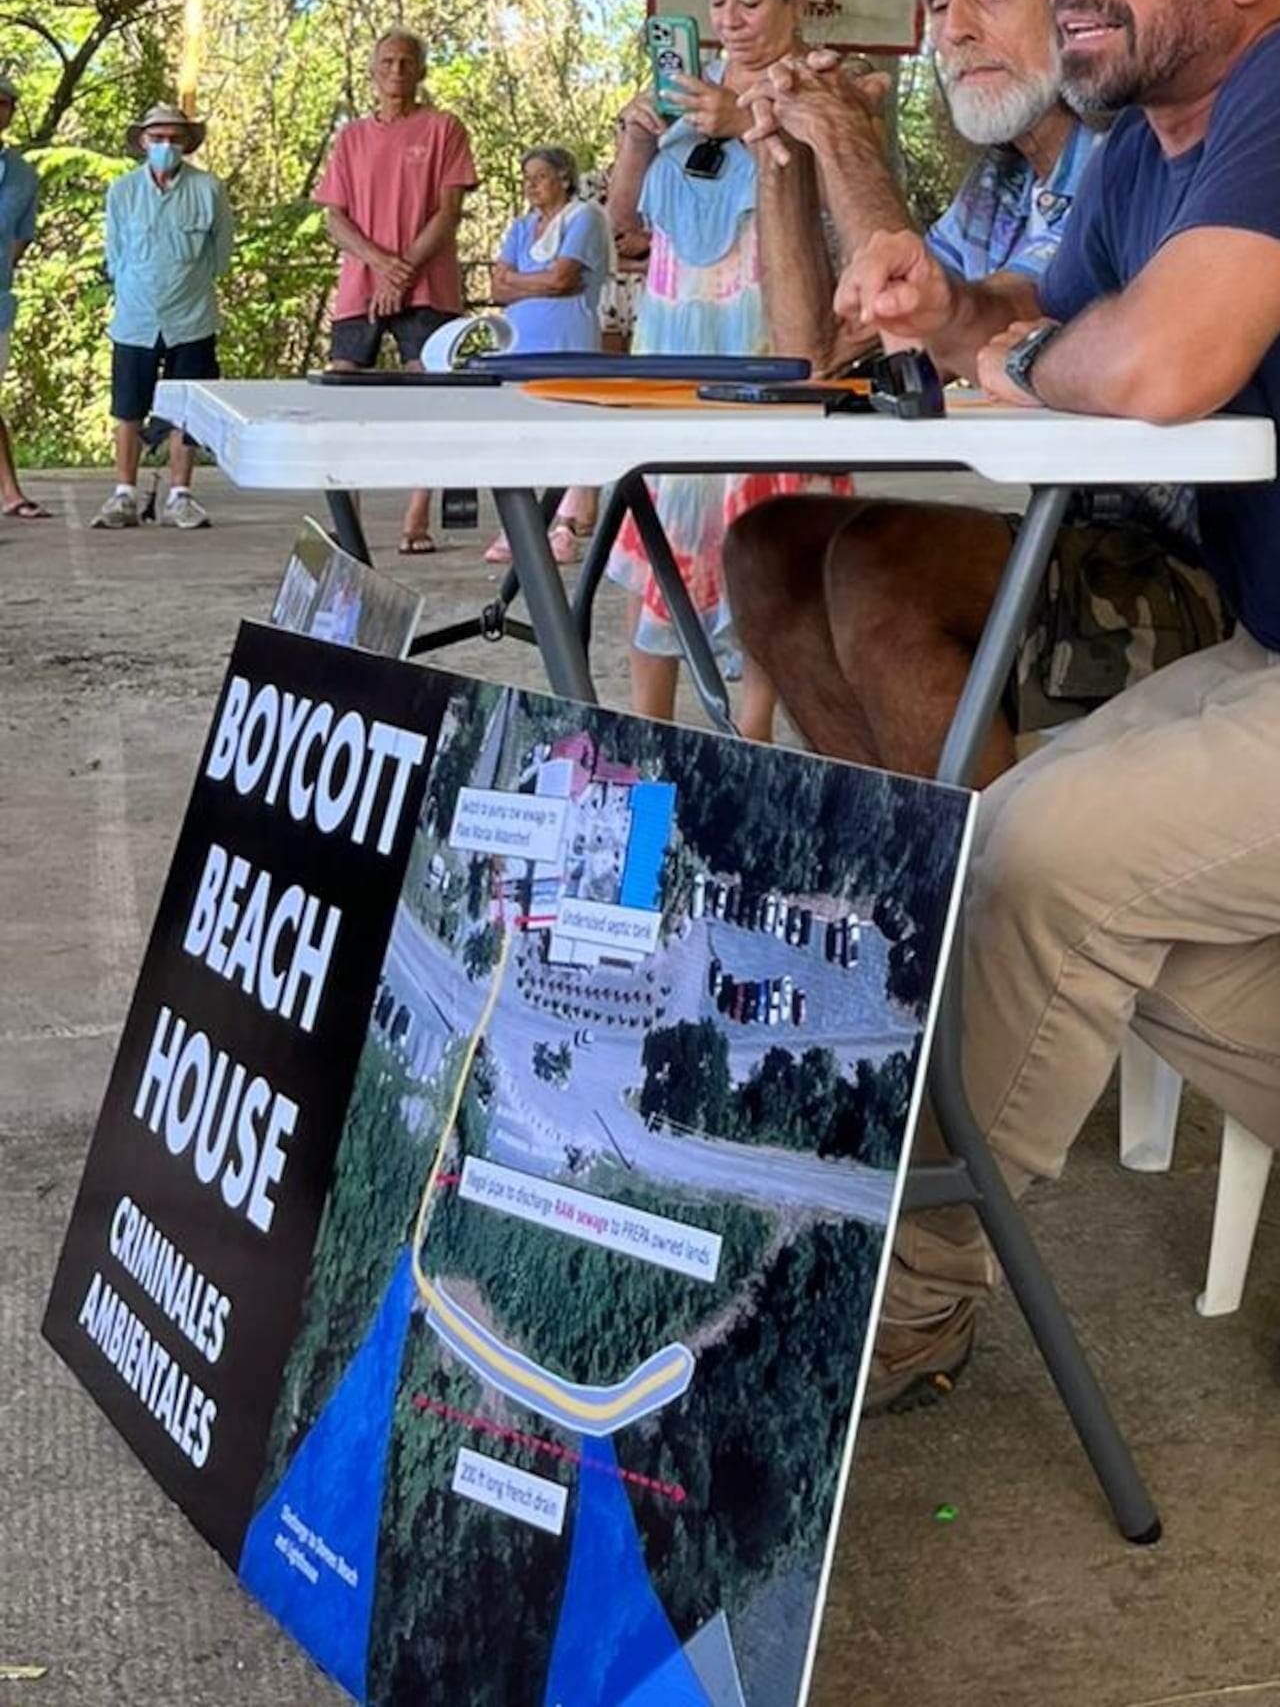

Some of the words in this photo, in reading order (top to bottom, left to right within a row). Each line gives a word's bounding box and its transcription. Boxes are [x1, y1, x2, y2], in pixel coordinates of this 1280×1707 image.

[206, 675, 428, 855] BOYCOTT
[183, 843, 342, 1032] BEACH
[133, 1006, 299, 1233] HOUSE
[109, 1196, 232, 1364] CRIMINALES
[555, 1198, 575, 1220] RAW
[576, 1209, 608, 1234] sewage
[651, 1233, 684, 1257] owned
[78, 1272, 217, 1468] AMBIENTALES
